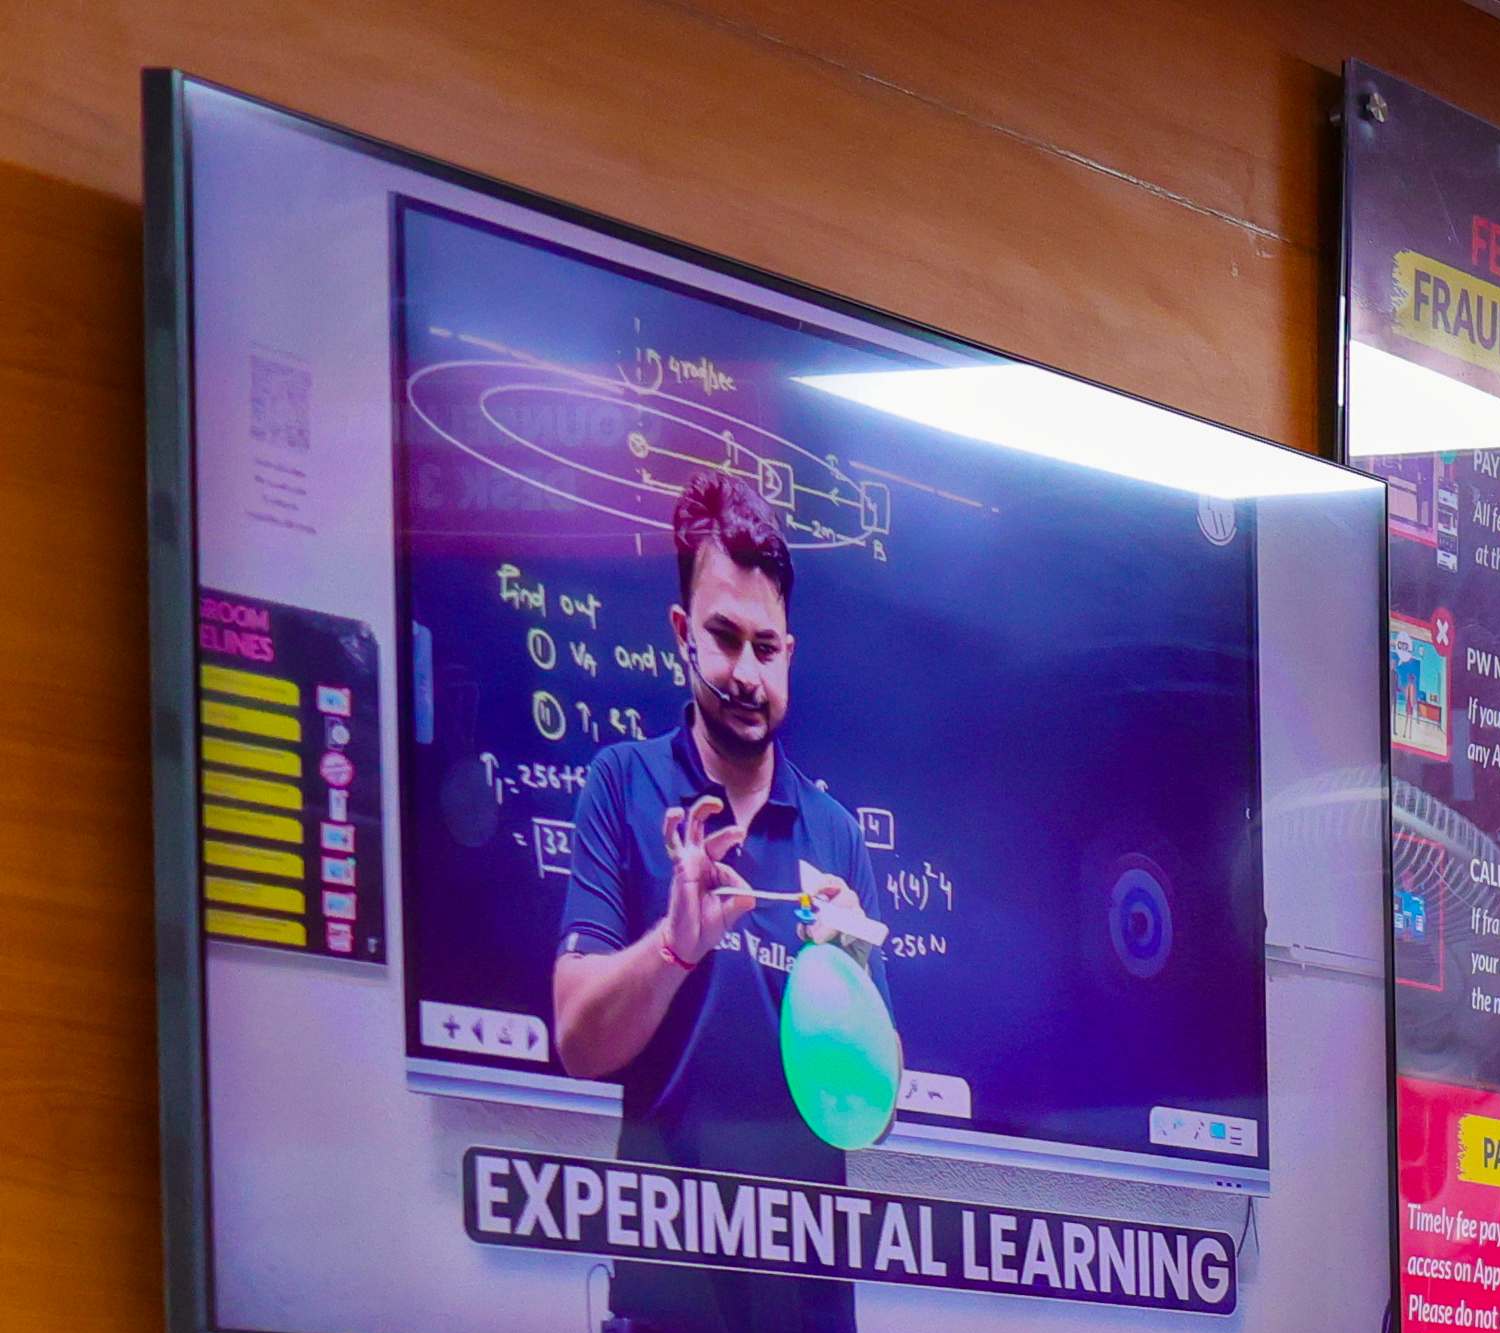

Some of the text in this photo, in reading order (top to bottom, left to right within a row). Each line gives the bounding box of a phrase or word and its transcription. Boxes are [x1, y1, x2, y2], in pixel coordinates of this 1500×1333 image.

[1472, 499, 1491, 528] All
[1475, 545, 1489, 567] at
[1467, 647, 1492, 677] PW
[475, 1155, 1231, 1305] EXPERIMENTAL LEARNING
